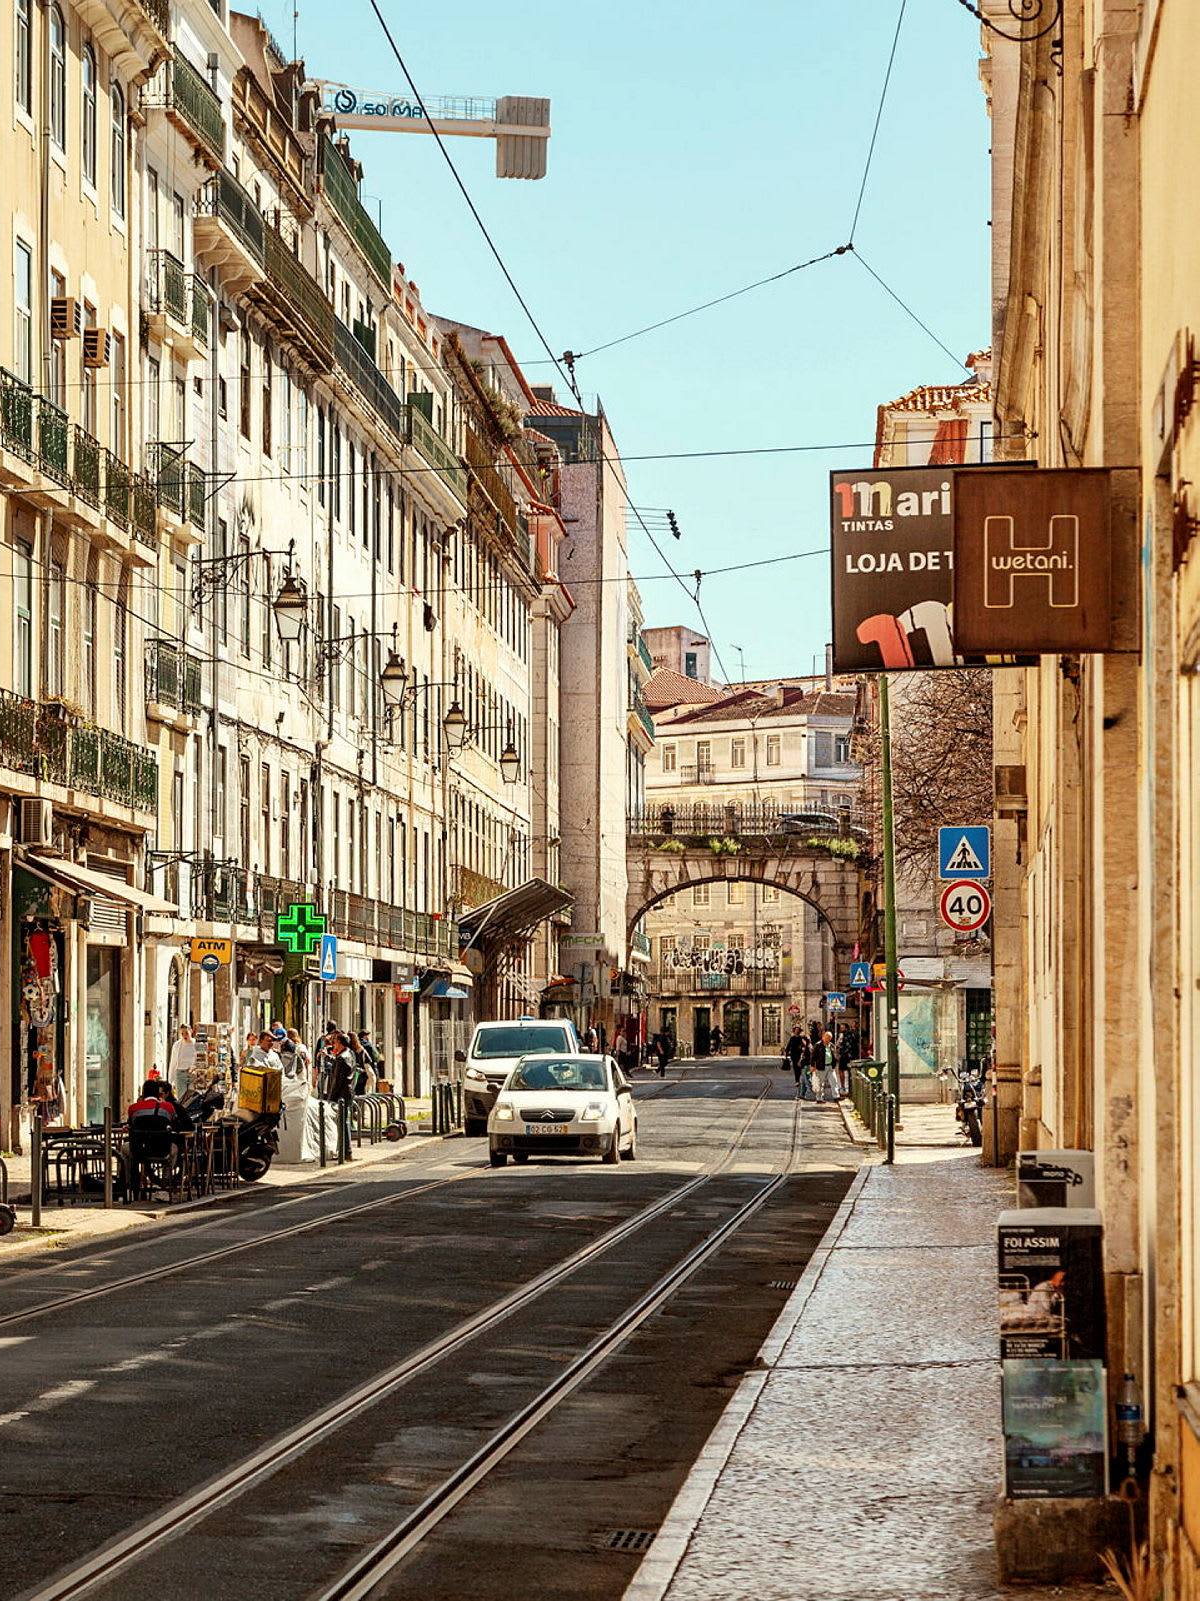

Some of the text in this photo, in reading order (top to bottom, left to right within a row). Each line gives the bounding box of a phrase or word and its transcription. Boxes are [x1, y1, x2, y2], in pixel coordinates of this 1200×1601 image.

[834, 481, 952, 518] mari
[841, 519, 894, 533] TINTAS
[846, 552, 904, 574] LOJA
[909, 551, 941, 571] DE
[949, 895, 982, 915] 40
[198, 941, 225, 950] ATM
[1004, 1237, 1060, 1248] FOI ASSIM
